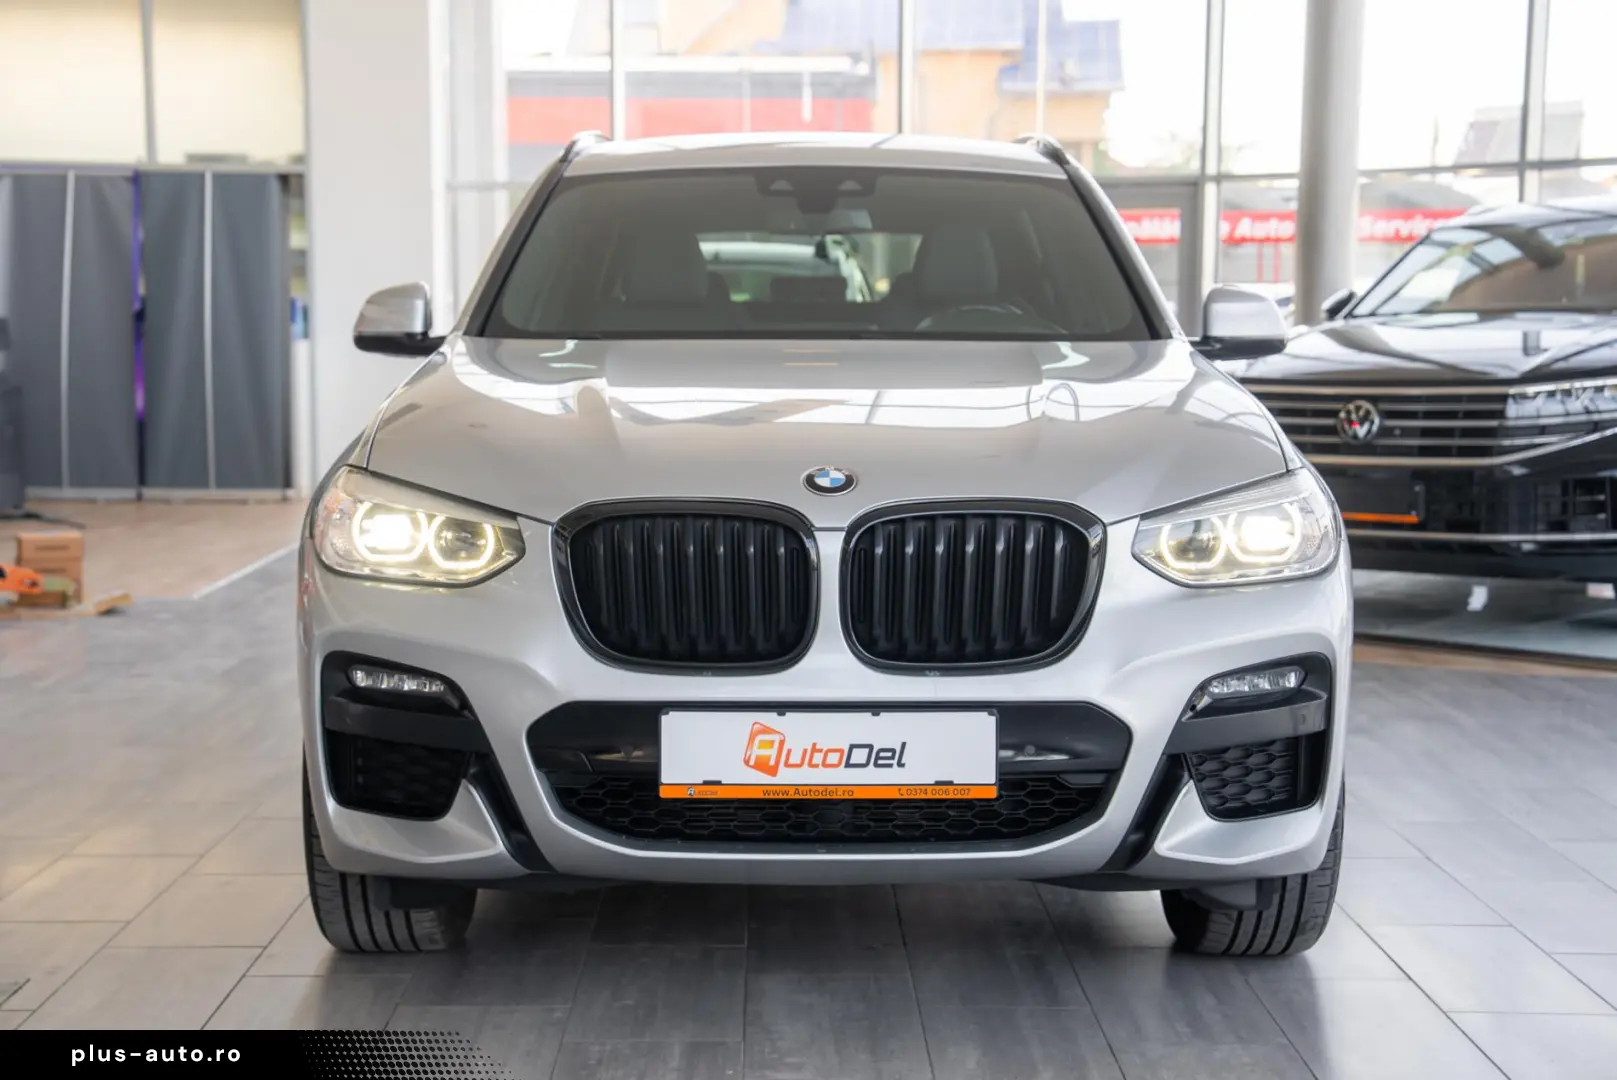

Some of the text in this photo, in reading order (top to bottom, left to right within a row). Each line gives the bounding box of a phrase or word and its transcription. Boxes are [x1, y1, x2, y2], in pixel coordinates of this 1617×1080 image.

[1234, 216, 1296, 239] Auto
[748, 732, 907, 769] AutoDel
[762, 787, 854, 797] www.Autodel.ro
[906, 788, 928, 796] 0374
